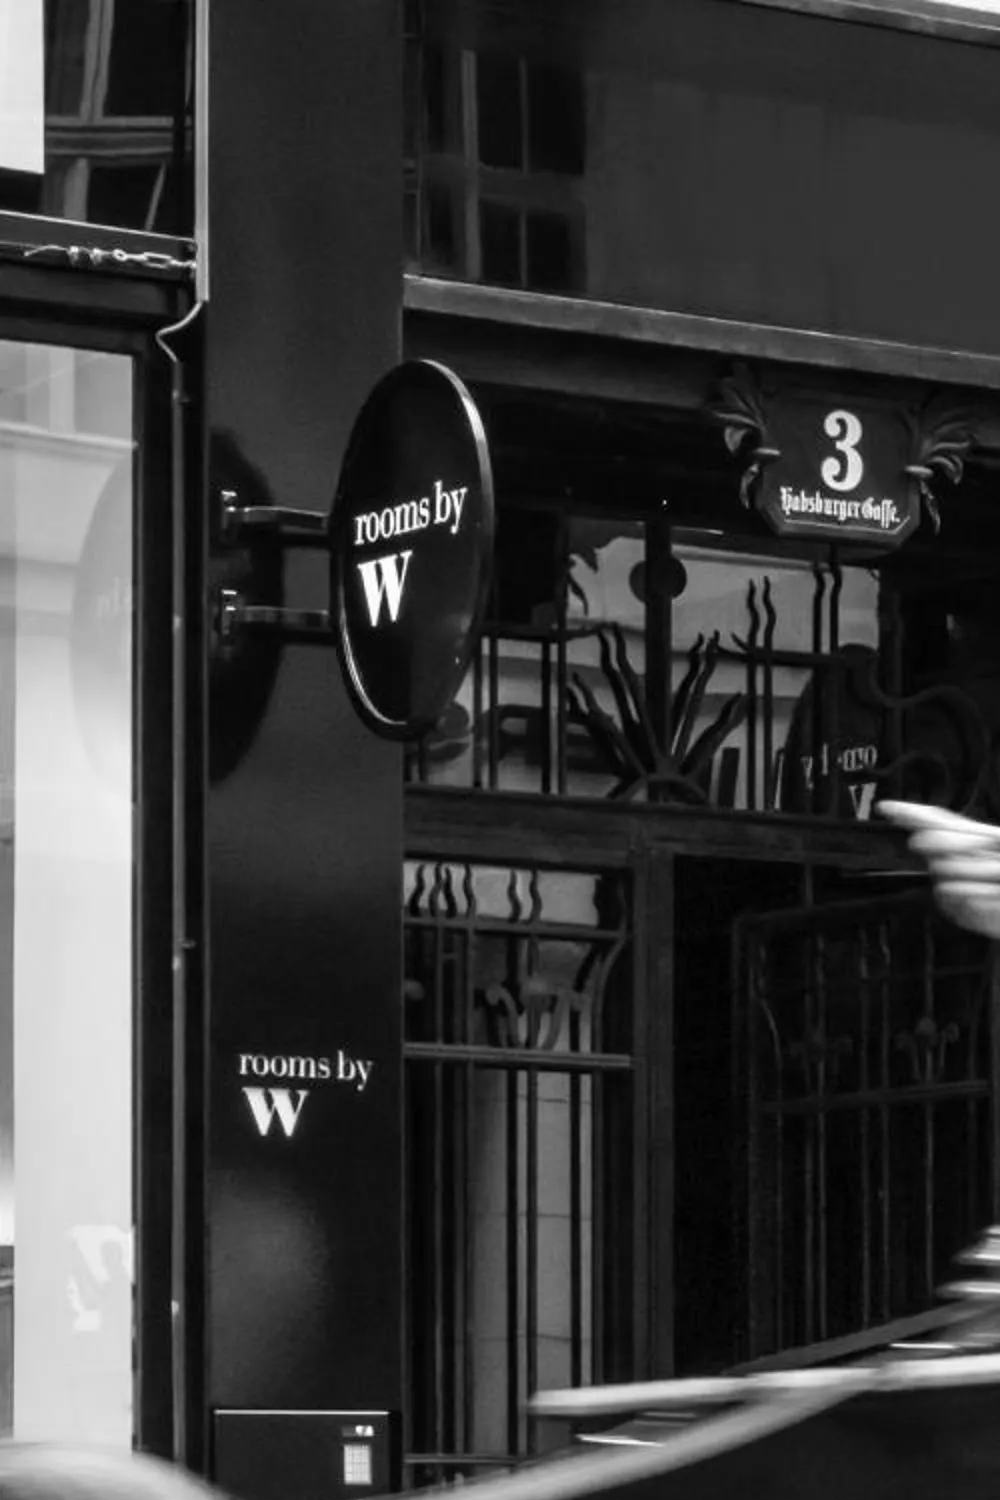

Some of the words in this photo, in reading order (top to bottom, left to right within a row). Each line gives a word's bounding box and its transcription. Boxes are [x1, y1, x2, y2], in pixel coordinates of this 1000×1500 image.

[821, 410, 864, 491] 3
[354, 497, 430, 545] rooms
[433, 480, 468, 534] by
[356, 549, 413, 627] W
[239, 1053, 331, 1079] rooms
[337, 1049, 374, 1092] by
[241, 1086, 310, 1137] W
